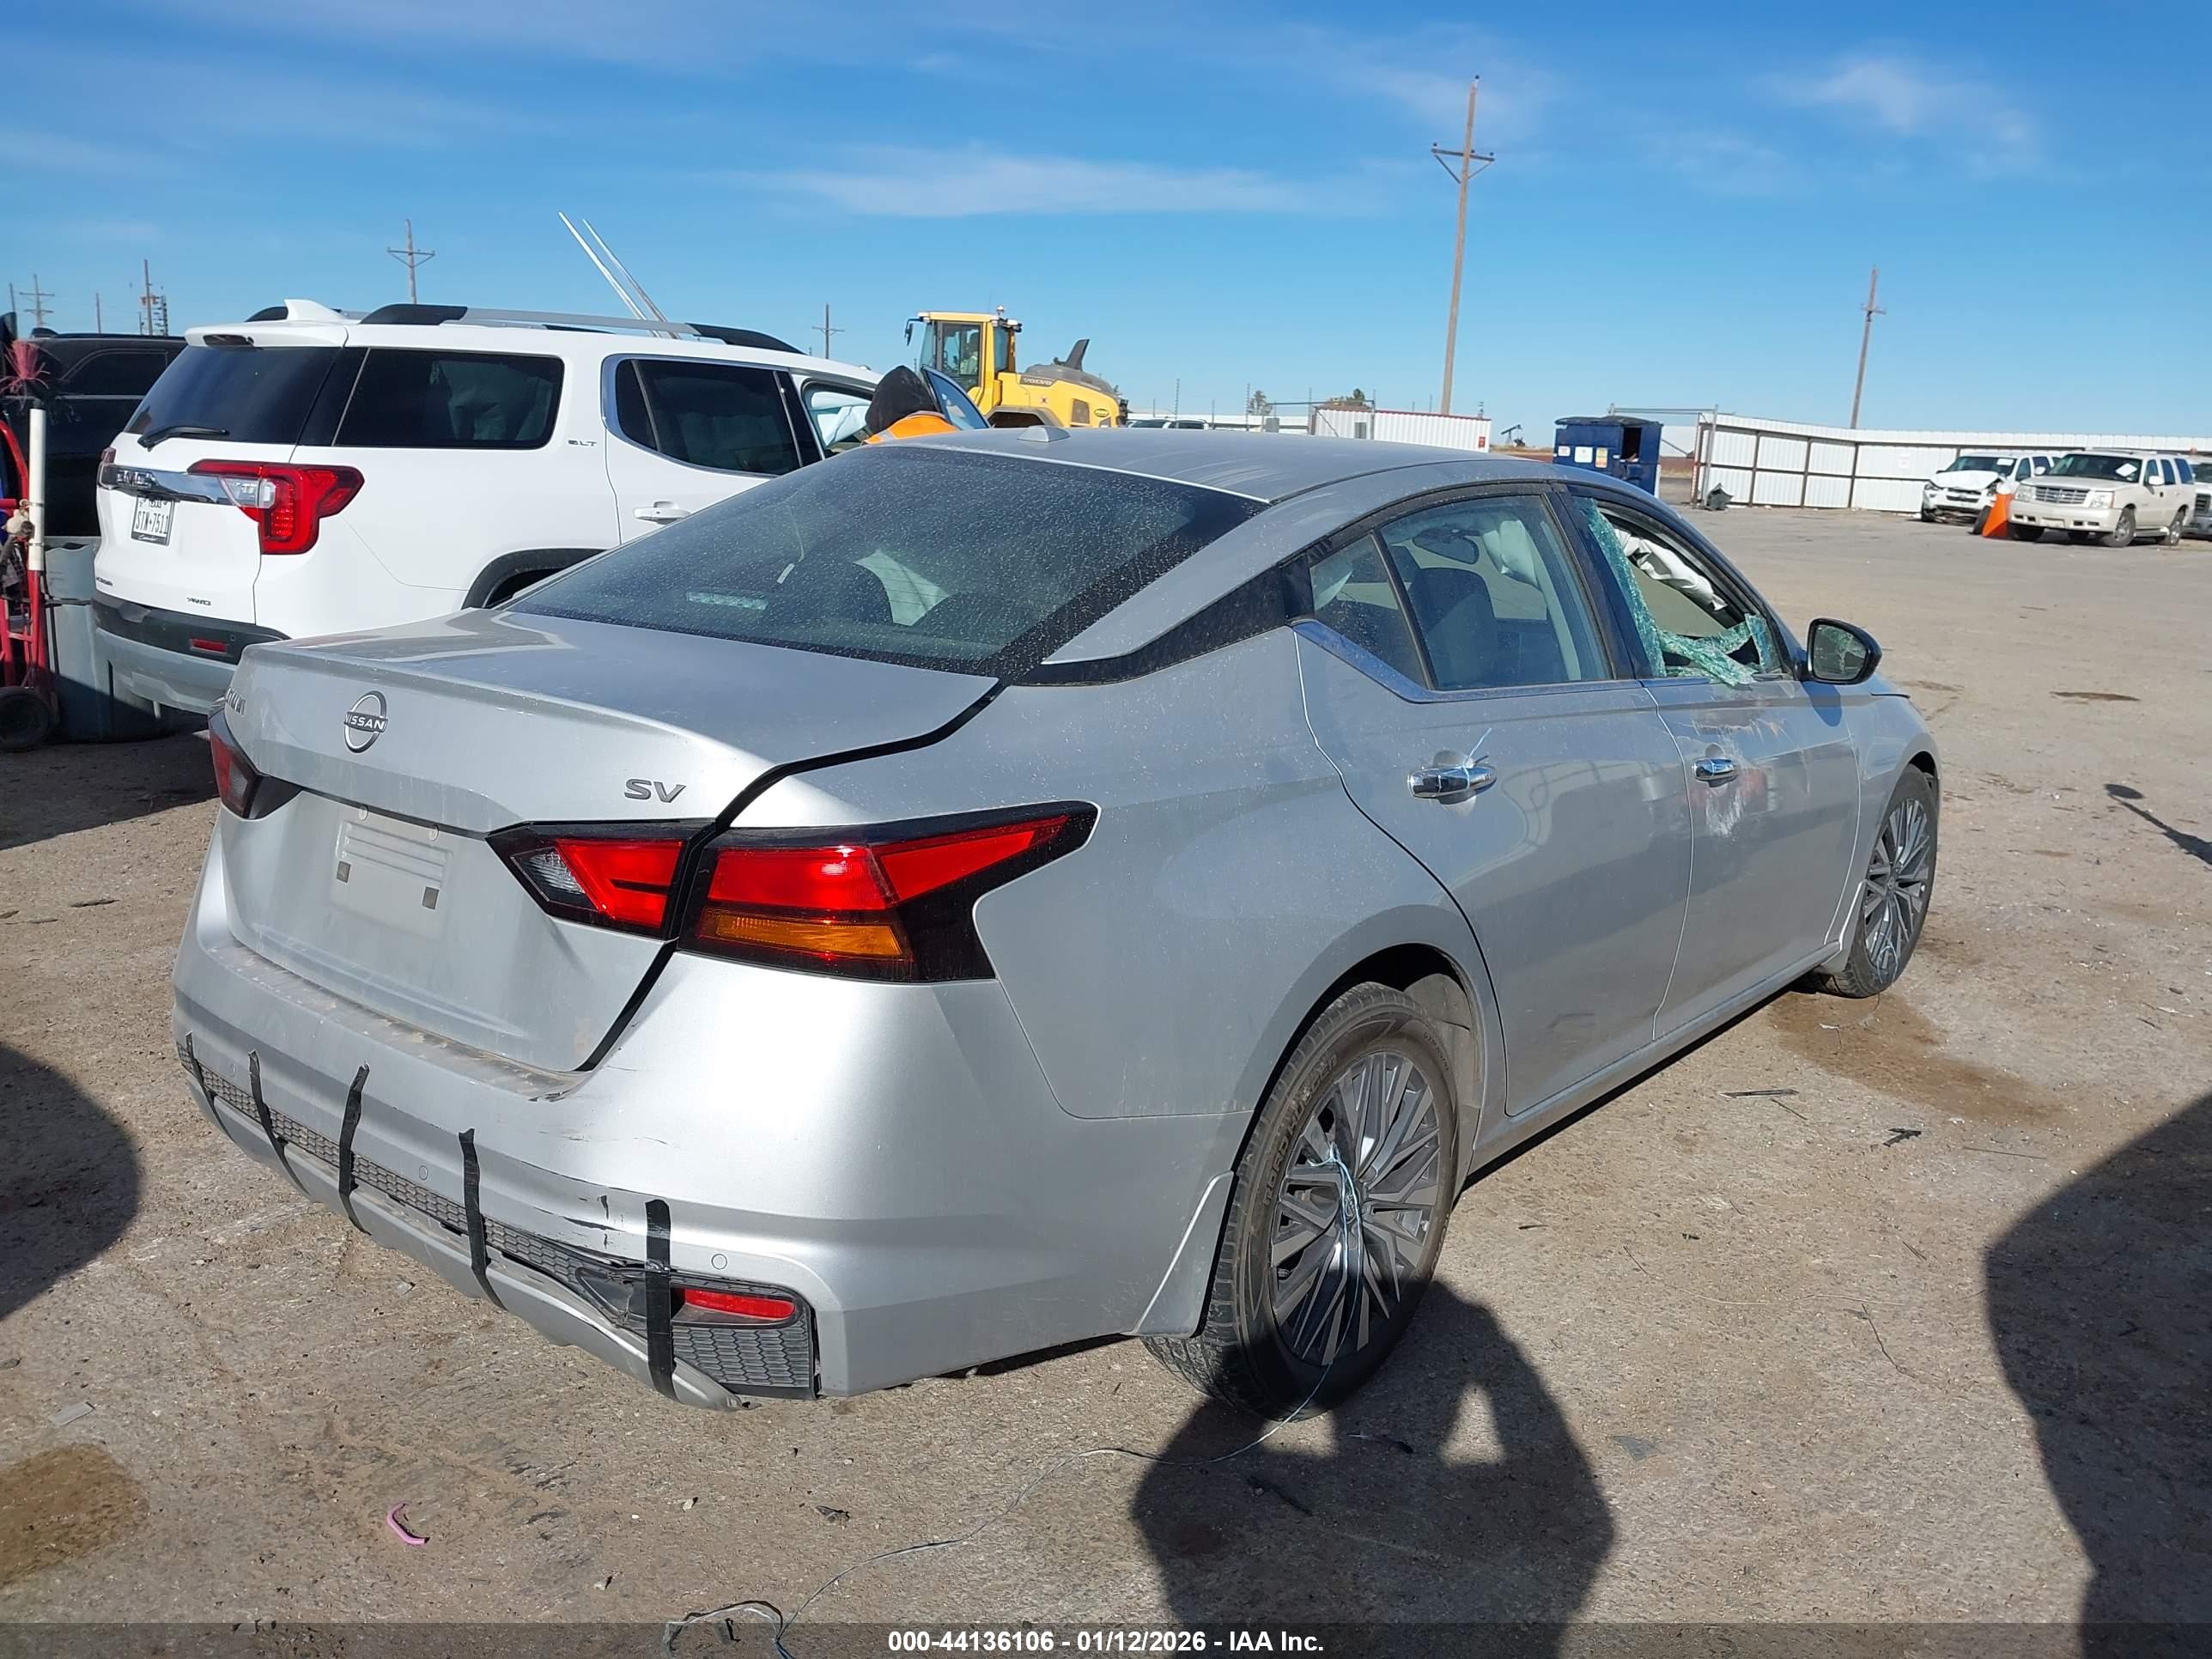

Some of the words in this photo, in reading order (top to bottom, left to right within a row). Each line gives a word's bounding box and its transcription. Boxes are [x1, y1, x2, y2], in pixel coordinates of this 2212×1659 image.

[1022, 377, 1053, 386] VOLVO
[343, 713, 387, 732] NISSAN
[623, 778, 687, 804] SV
